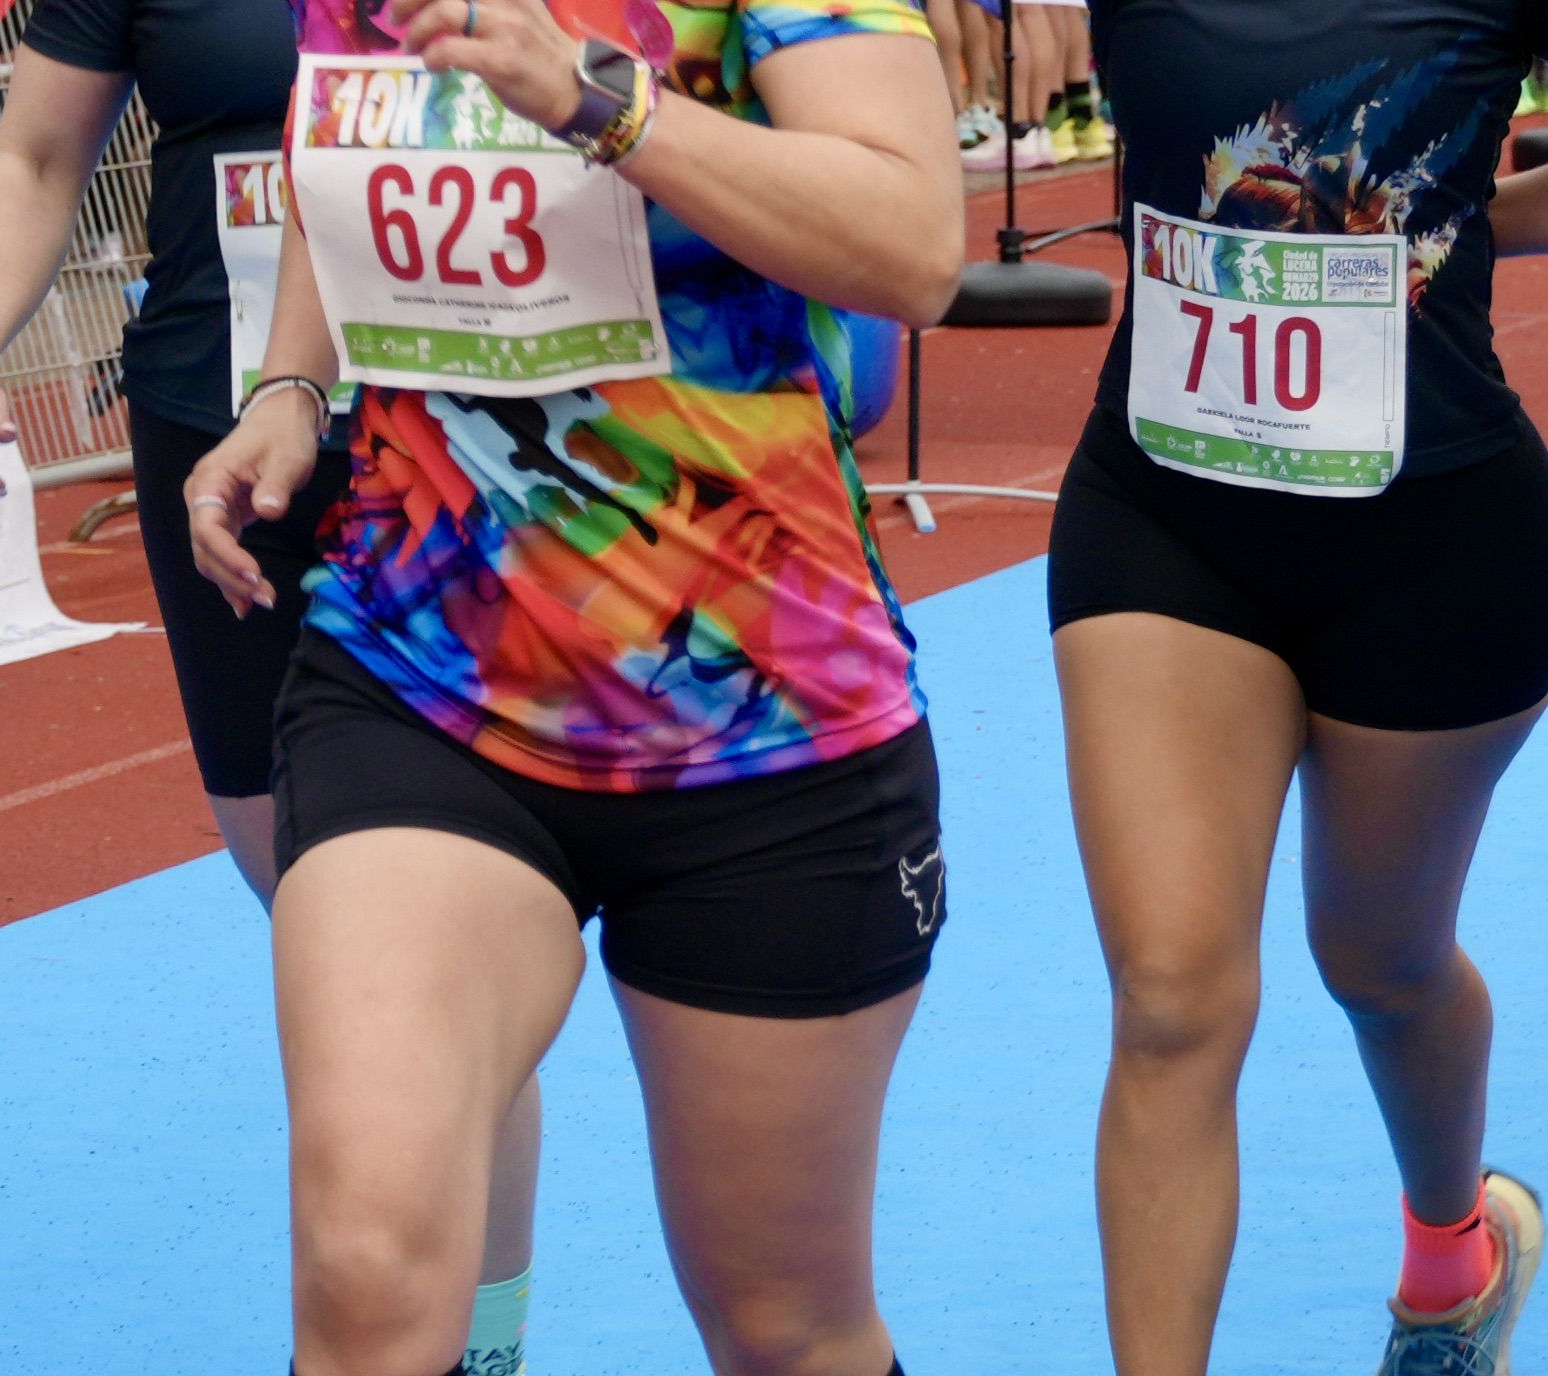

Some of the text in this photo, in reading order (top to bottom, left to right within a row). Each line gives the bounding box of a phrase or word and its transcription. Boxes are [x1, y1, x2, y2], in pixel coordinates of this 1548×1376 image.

[332, 71, 432, 147] 10K
[366, 163, 547, 288] 623
[1153, 224, 1220, 296] 10K
[1281, 283, 1319, 302] 2026
[1179, 299, 1322, 413] 710
